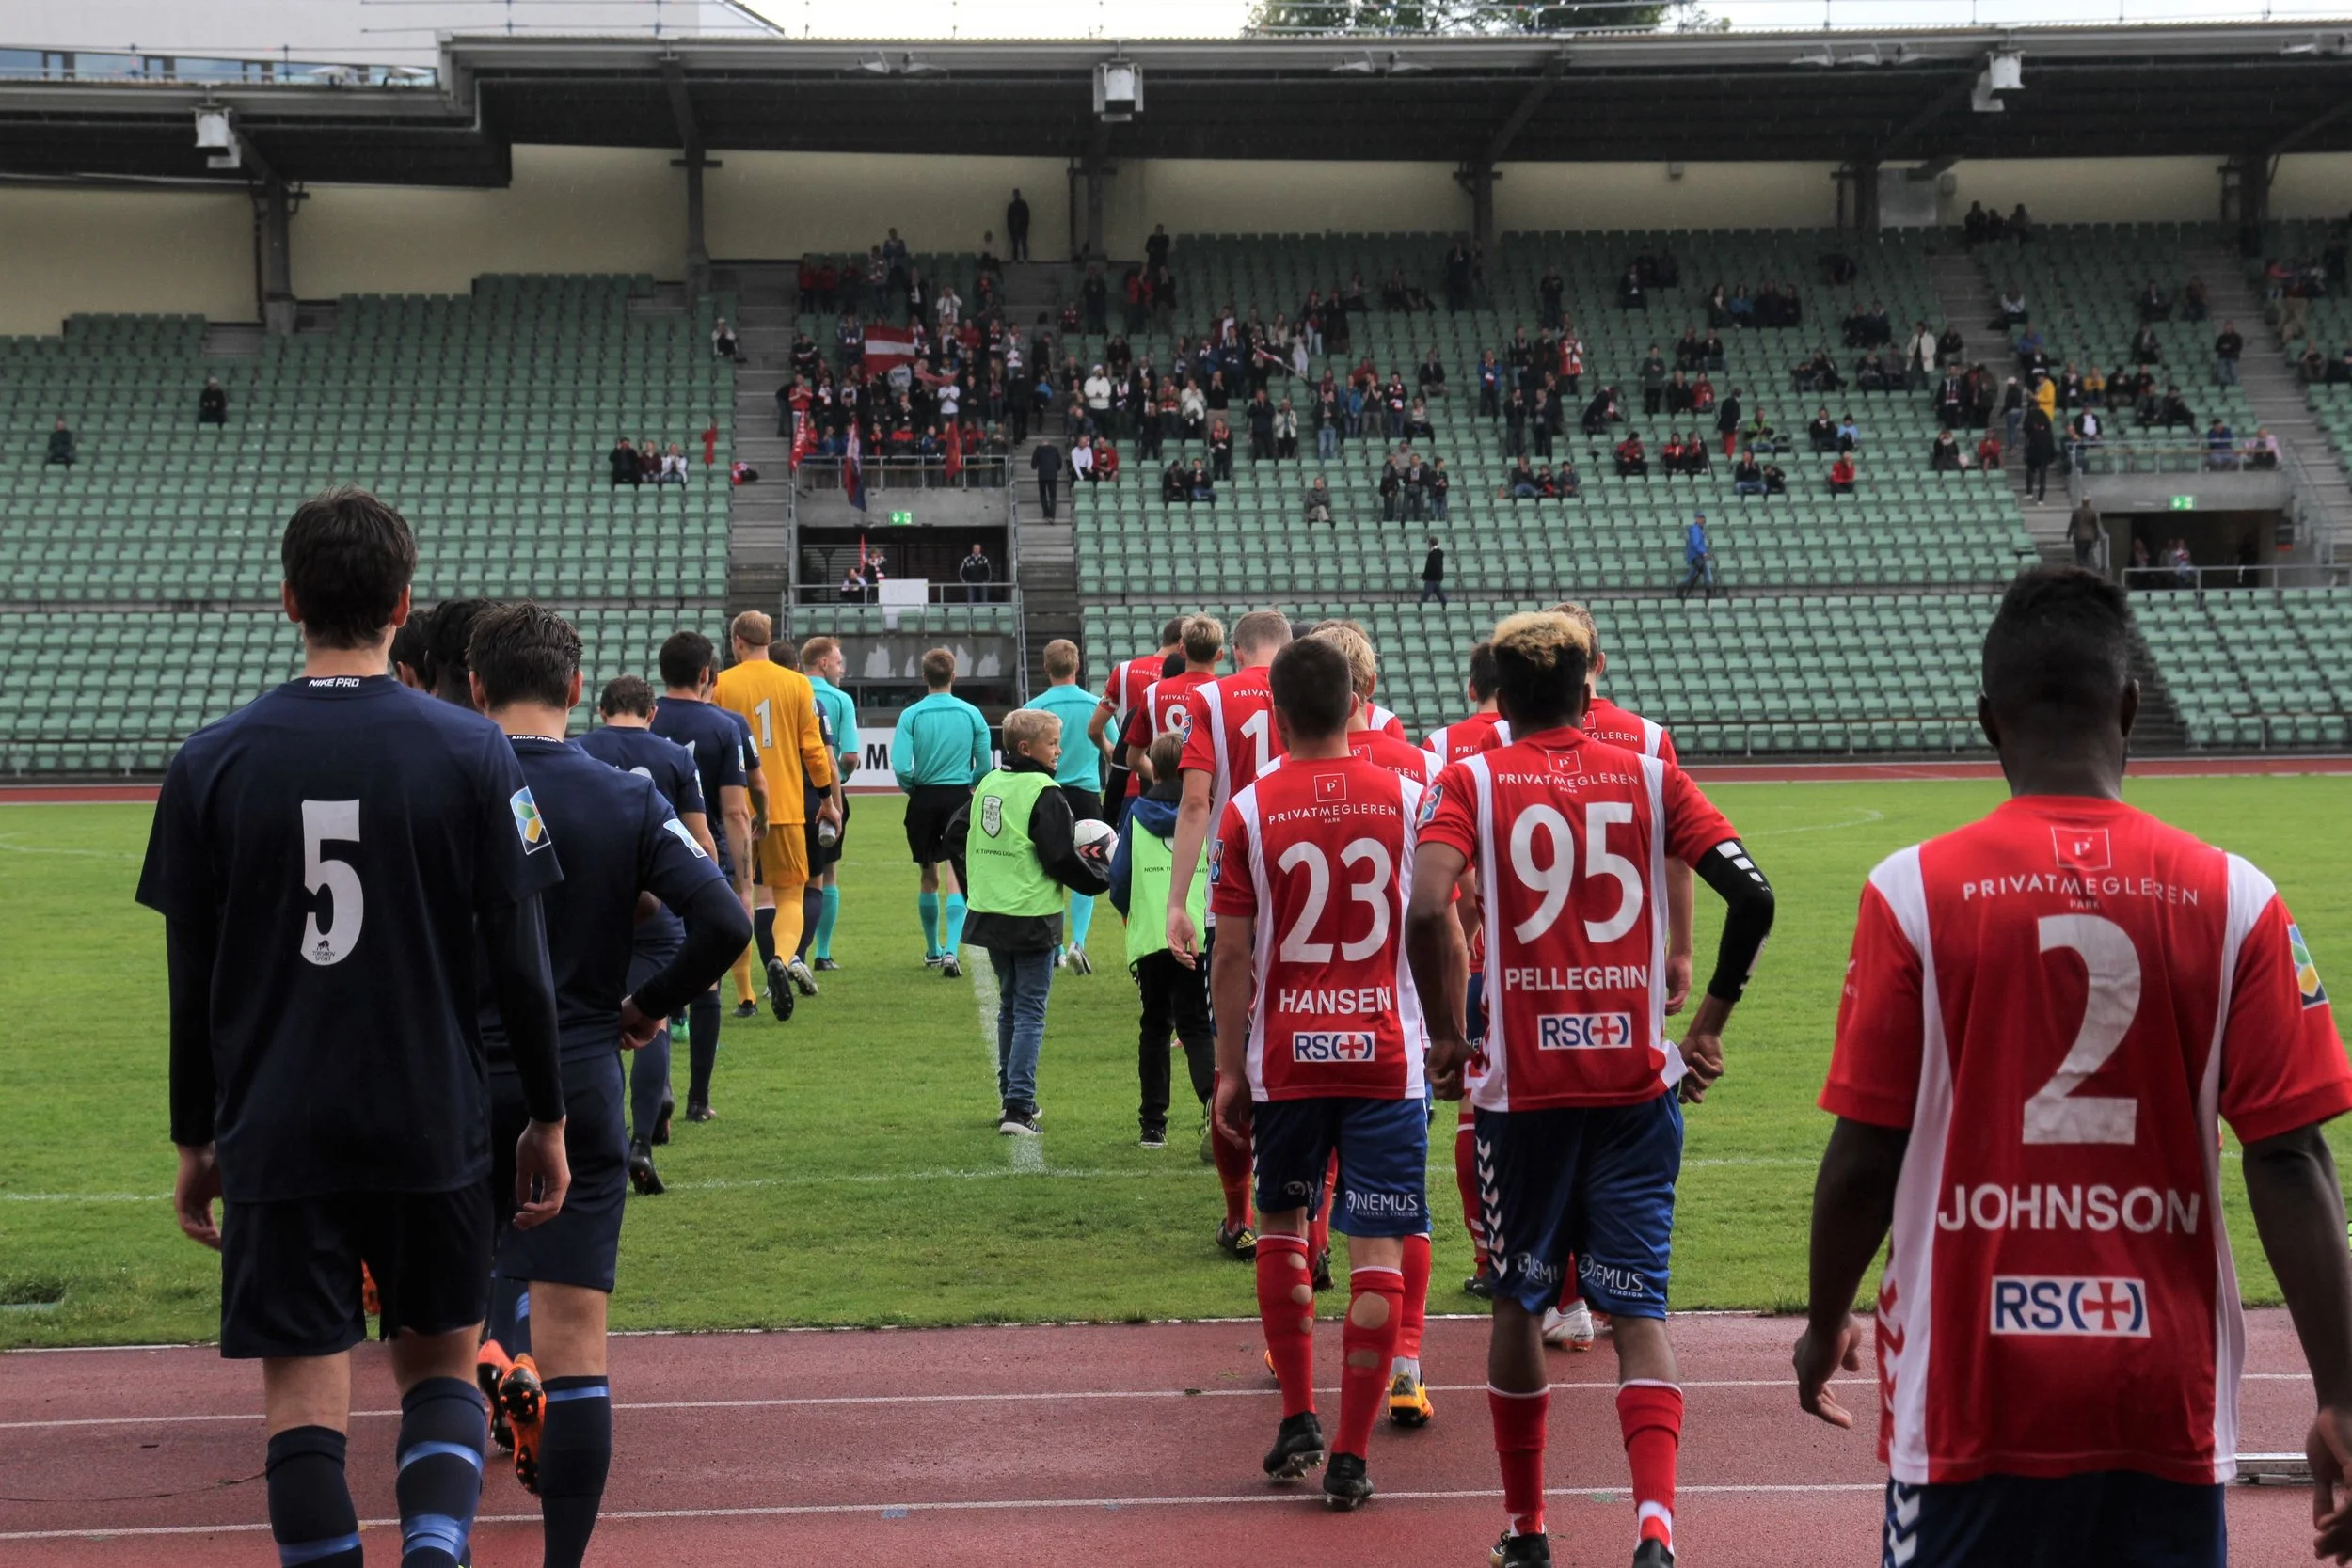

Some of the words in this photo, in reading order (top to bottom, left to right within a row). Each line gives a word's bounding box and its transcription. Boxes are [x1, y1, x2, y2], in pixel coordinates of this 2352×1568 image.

[309, 678, 335, 688] NIKE
[336, 677, 360, 688] PRO
[755, 698, 772, 749] 1
[1498, 772, 1639, 788] PRIVATMEGLEREN
[1267, 803, 1398, 826] PRIVATMEGLEREN
[300, 799, 365, 966] 5
[1509, 801, 1644, 945] 95
[1963, 873, 2199, 906] PRIVATMEGLEREN
[1277, 837, 1391, 964] 23
[2070, 899, 2101, 911] PARK
[1505, 965, 1648, 991] PELLEGRIN
[1279, 986, 1391, 1015] HANSEN
[2022, 913, 2142, 1145] 2
[1937, 1183, 2201, 1235] JOHNSON
